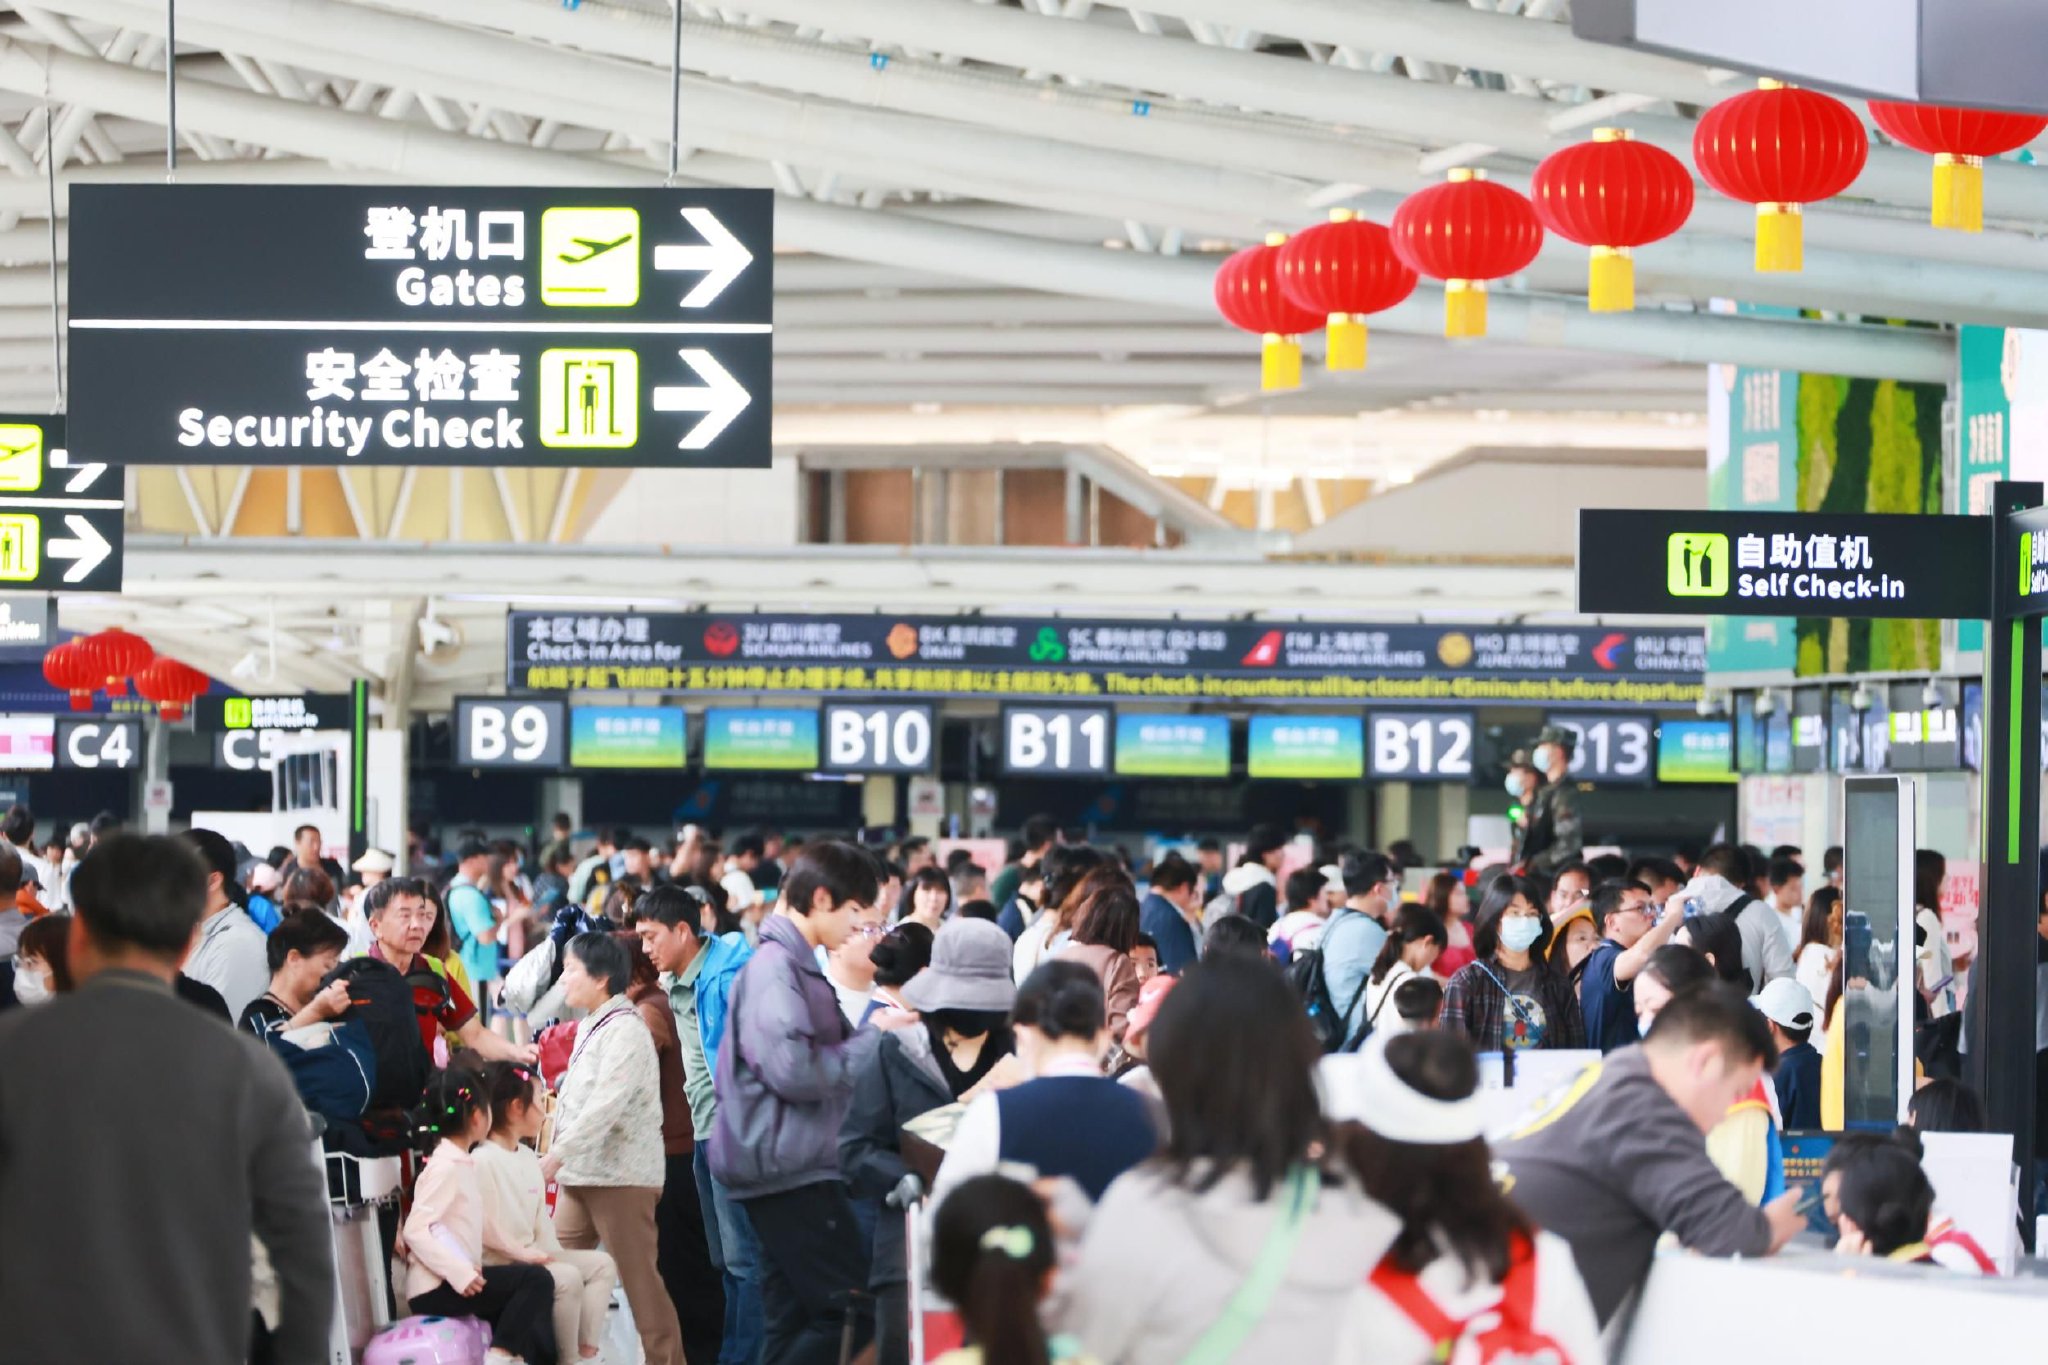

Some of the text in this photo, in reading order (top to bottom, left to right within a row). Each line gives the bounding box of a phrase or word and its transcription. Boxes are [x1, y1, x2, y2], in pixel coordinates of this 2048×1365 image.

[364, 206, 525, 261] 登机口
[395, 267, 526, 307] Gates
[304, 348, 521, 402] 安全检查
[177, 406, 525, 457] Security Check
[1736, 532, 1873, 570] 自助值机
[1737, 573, 1905, 599] Self Check-in
[526, 642, 682, 661] Check-in Area for
[527, 617, 650, 643] 本区域办理
[1317, 632, 1390, 652] 上海航空
[68, 723, 132, 768] C4
[470, 705, 549, 762] B9
[830, 709, 931, 765] B10
[1009, 712, 1106, 769] B11
[1374, 718, 1471, 773] B12
